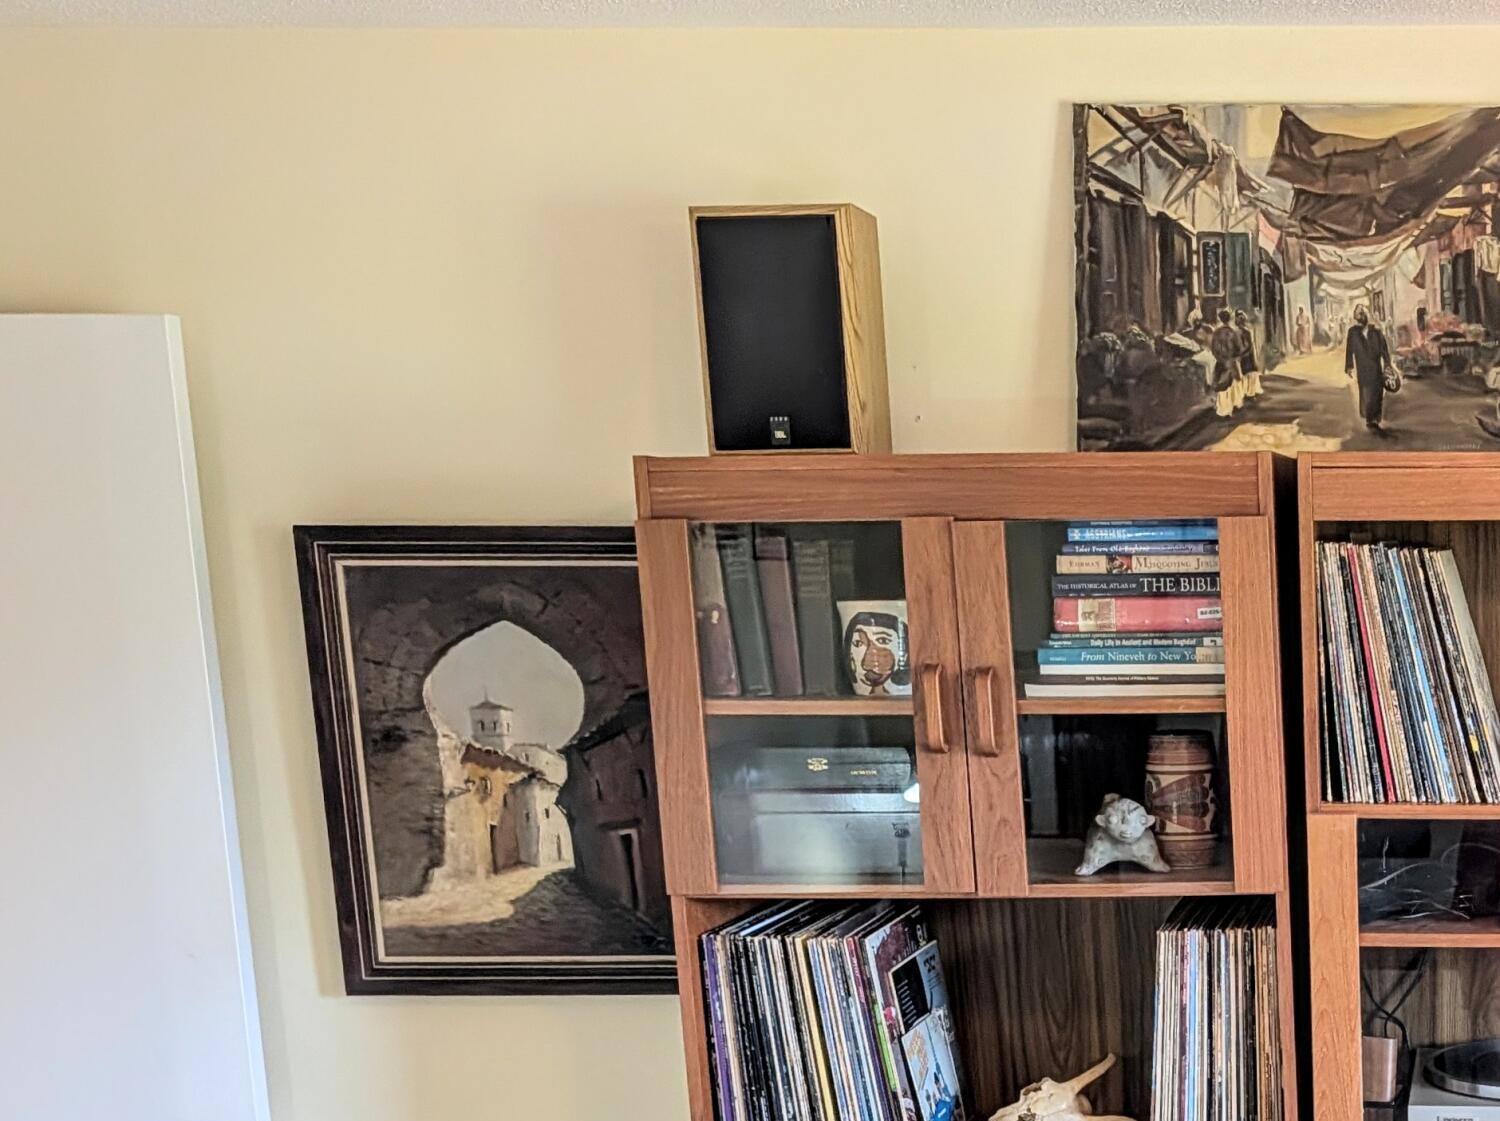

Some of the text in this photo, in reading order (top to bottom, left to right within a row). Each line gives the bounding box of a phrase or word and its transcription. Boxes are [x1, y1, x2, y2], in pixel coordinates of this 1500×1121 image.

[1092, 545, 1108, 553] From
[1140, 577, 1176, 593] THE
[1090, 639, 1103, 648] Daily
[1104, 639, 1114, 647] Life
[1121, 639, 1142, 647] Ancient
[1142, 638, 1152, 646] and
[1081, 651, 1104, 661] From
[1107, 651, 1145, 661] Nineveh
[1148, 651, 1157, 661] to
[1159, 651, 1181, 660] New
